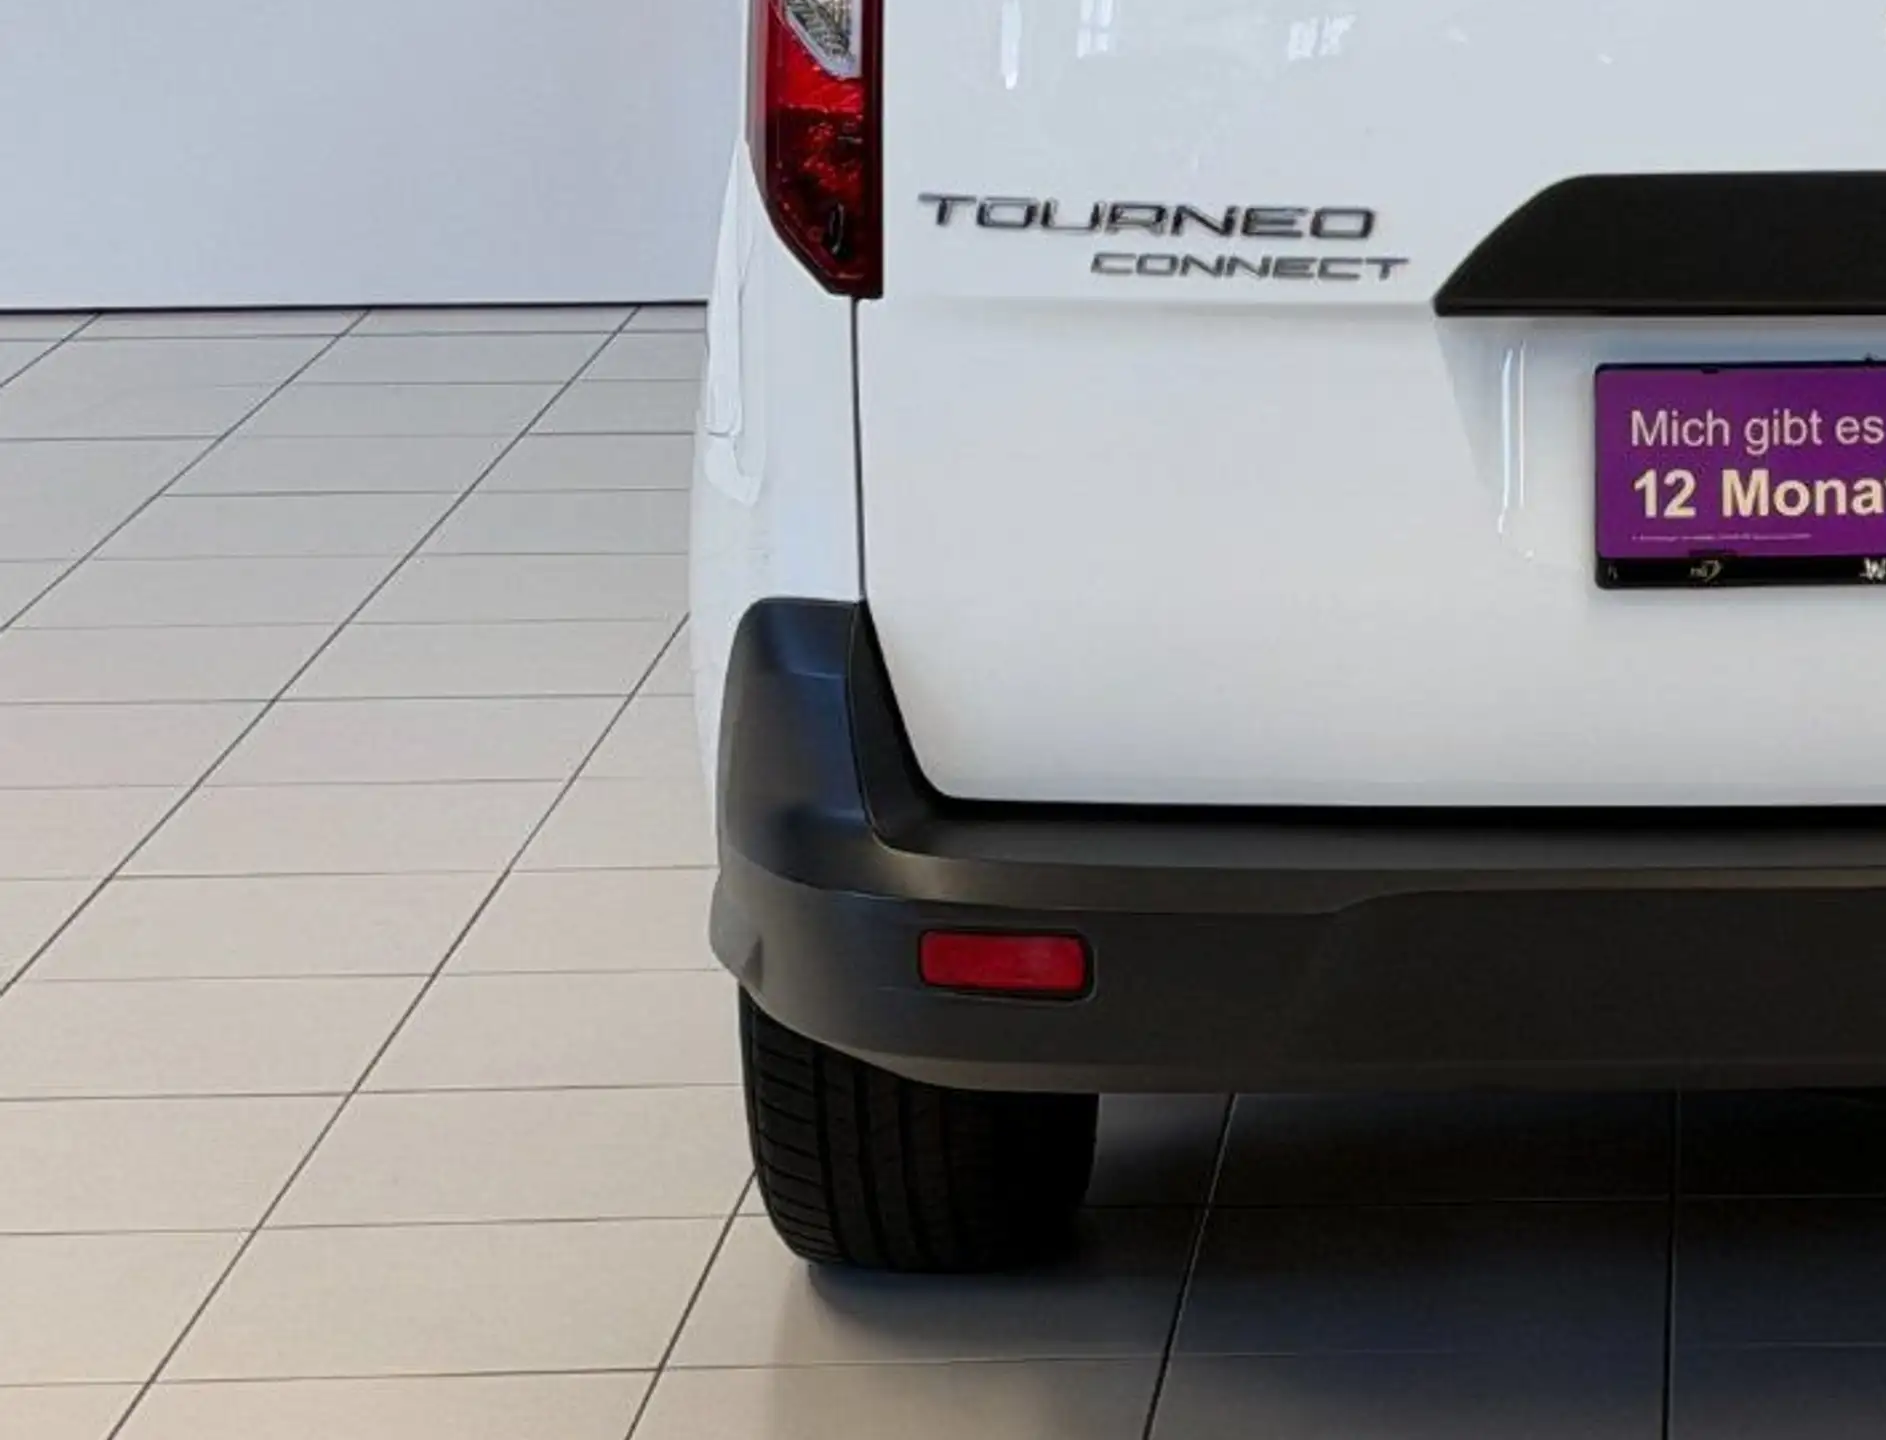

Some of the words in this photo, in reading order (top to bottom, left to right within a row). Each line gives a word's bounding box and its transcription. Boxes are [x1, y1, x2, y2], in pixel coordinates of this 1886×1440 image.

[918, 193, 1378, 241] TOURNEO
[1090, 252, 1409, 281] CONNECT
[1630, 408, 1731, 448] Mich
[1744, 408, 1823, 456] gibt
[1834, 414, 1886, 445] es
[1633, 468, 1697, 519] 12
